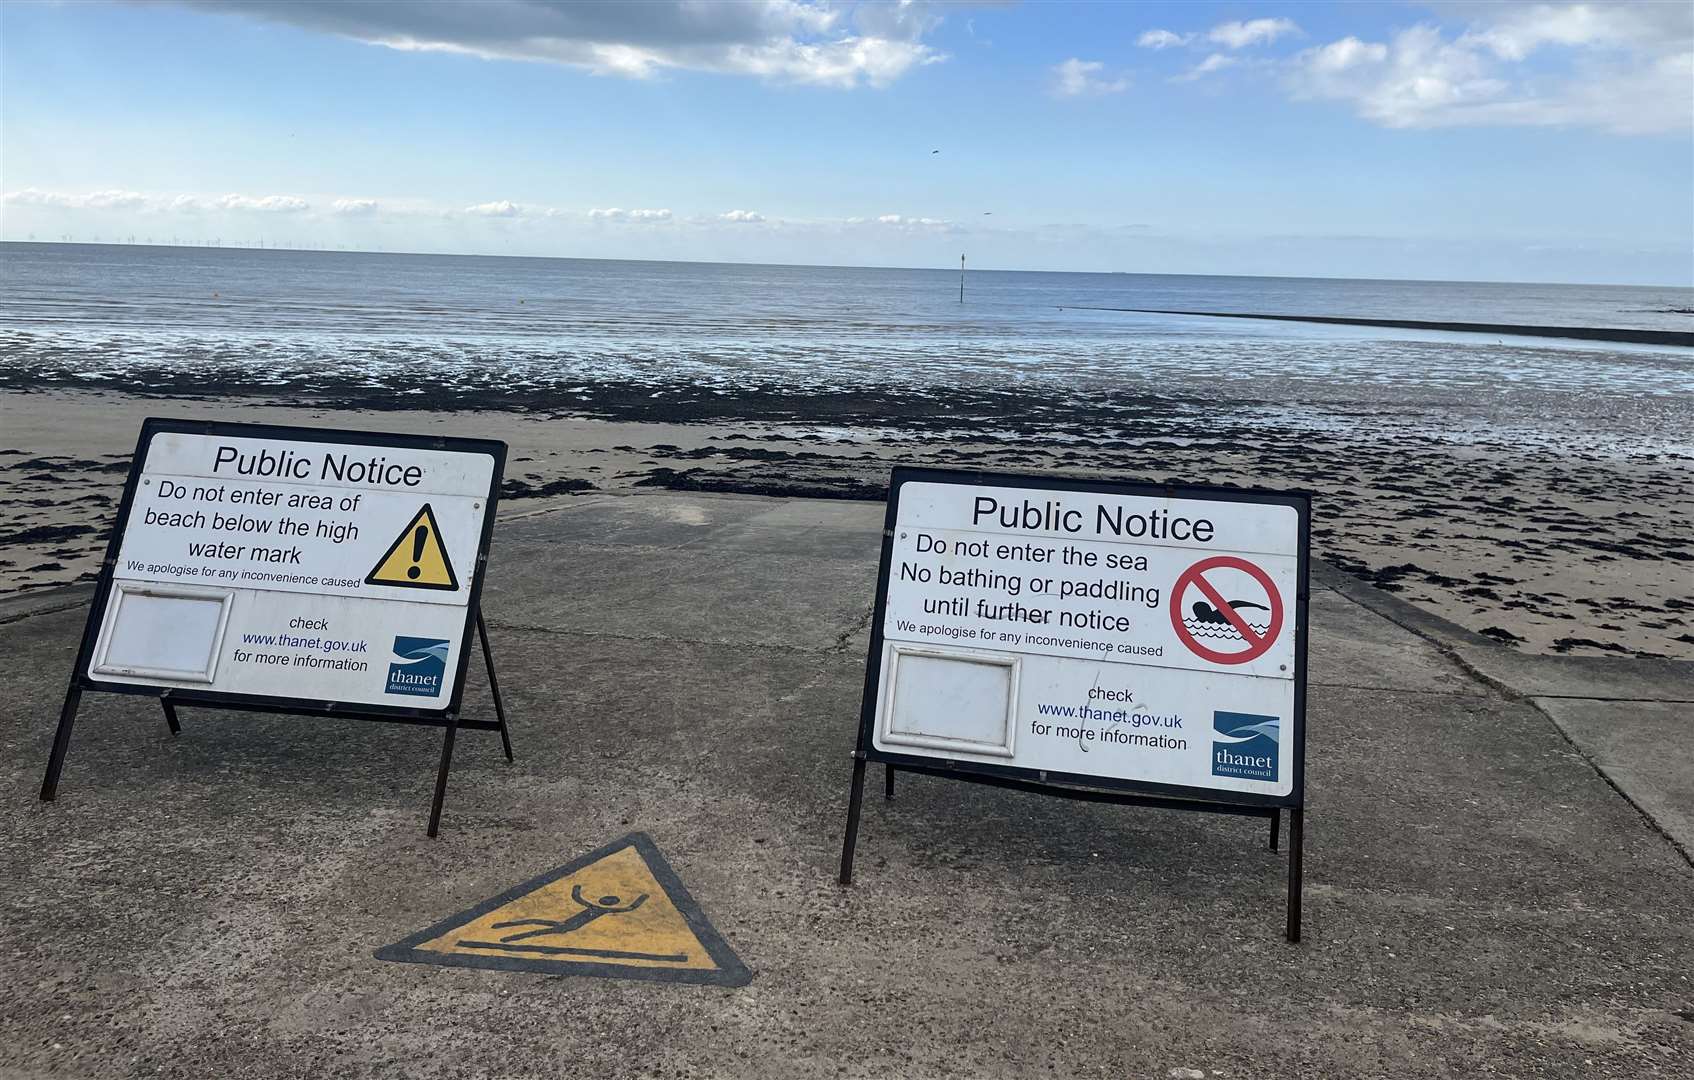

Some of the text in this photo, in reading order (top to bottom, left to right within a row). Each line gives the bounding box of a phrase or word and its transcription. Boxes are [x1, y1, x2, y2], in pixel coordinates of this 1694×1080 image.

[213, 446, 422, 486] Public Notice
[158, 481, 360, 512] Do not enter area of
[144, 509, 359, 543] beach below the high
[973, 496, 1214, 542] Public Notice
[189, 543, 301, 564] water mark
[916, 535, 1148, 570] Do not enter the sea
[128, 561, 360, 588] We apologise for any inconvenience caused
[901, 564, 1160, 607] No bathing or paddling
[289, 617, 328, 630] check
[923, 597, 1130, 631] until further notice
[243, 633, 368, 654] www.thanet.gov.uk
[897, 621, 1163, 657] We apologise for any inconvenience caused
[234, 649, 368, 672] for more information
[391, 670, 437, 686] thanet
[1088, 687, 1133, 702] check
[1038, 701, 1183, 729] www.thanet.gov.uk
[1031, 721, 1187, 750] for more information
[1216, 750, 1272, 768] thanet
[1217, 765, 1271, 777] district council
